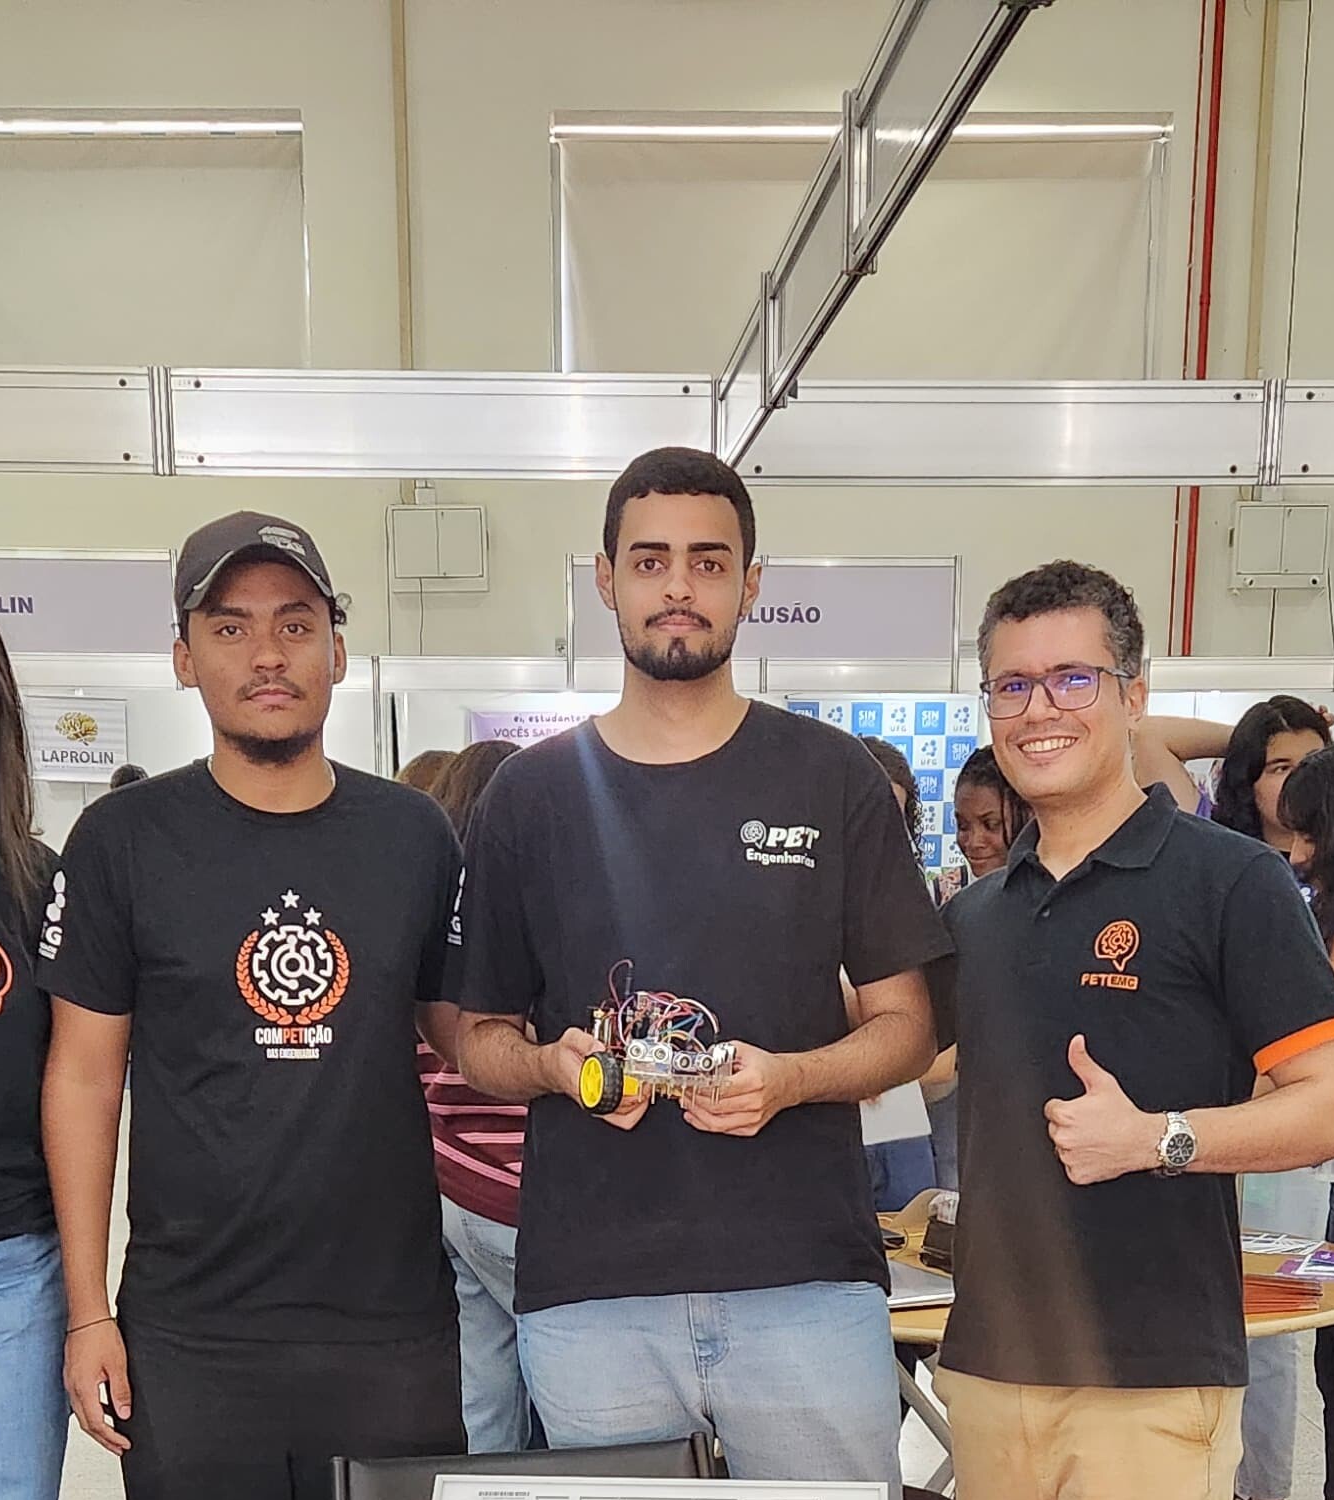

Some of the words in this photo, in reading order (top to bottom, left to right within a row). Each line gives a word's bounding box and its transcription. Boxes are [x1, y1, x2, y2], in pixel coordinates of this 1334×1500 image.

[739, 602, 821, 624] LUSÃO
[858, 710, 877, 720] SIN
[921, 710, 940, 720] SIN
[493, 727, 530, 738] VOCÊS
[41, 749, 114, 764] LAPROLIN
[919, 776, 938, 785] SIN
[766, 826, 820, 849] PET
[254, 1024, 333, 1048] COMPETIÇÃO
